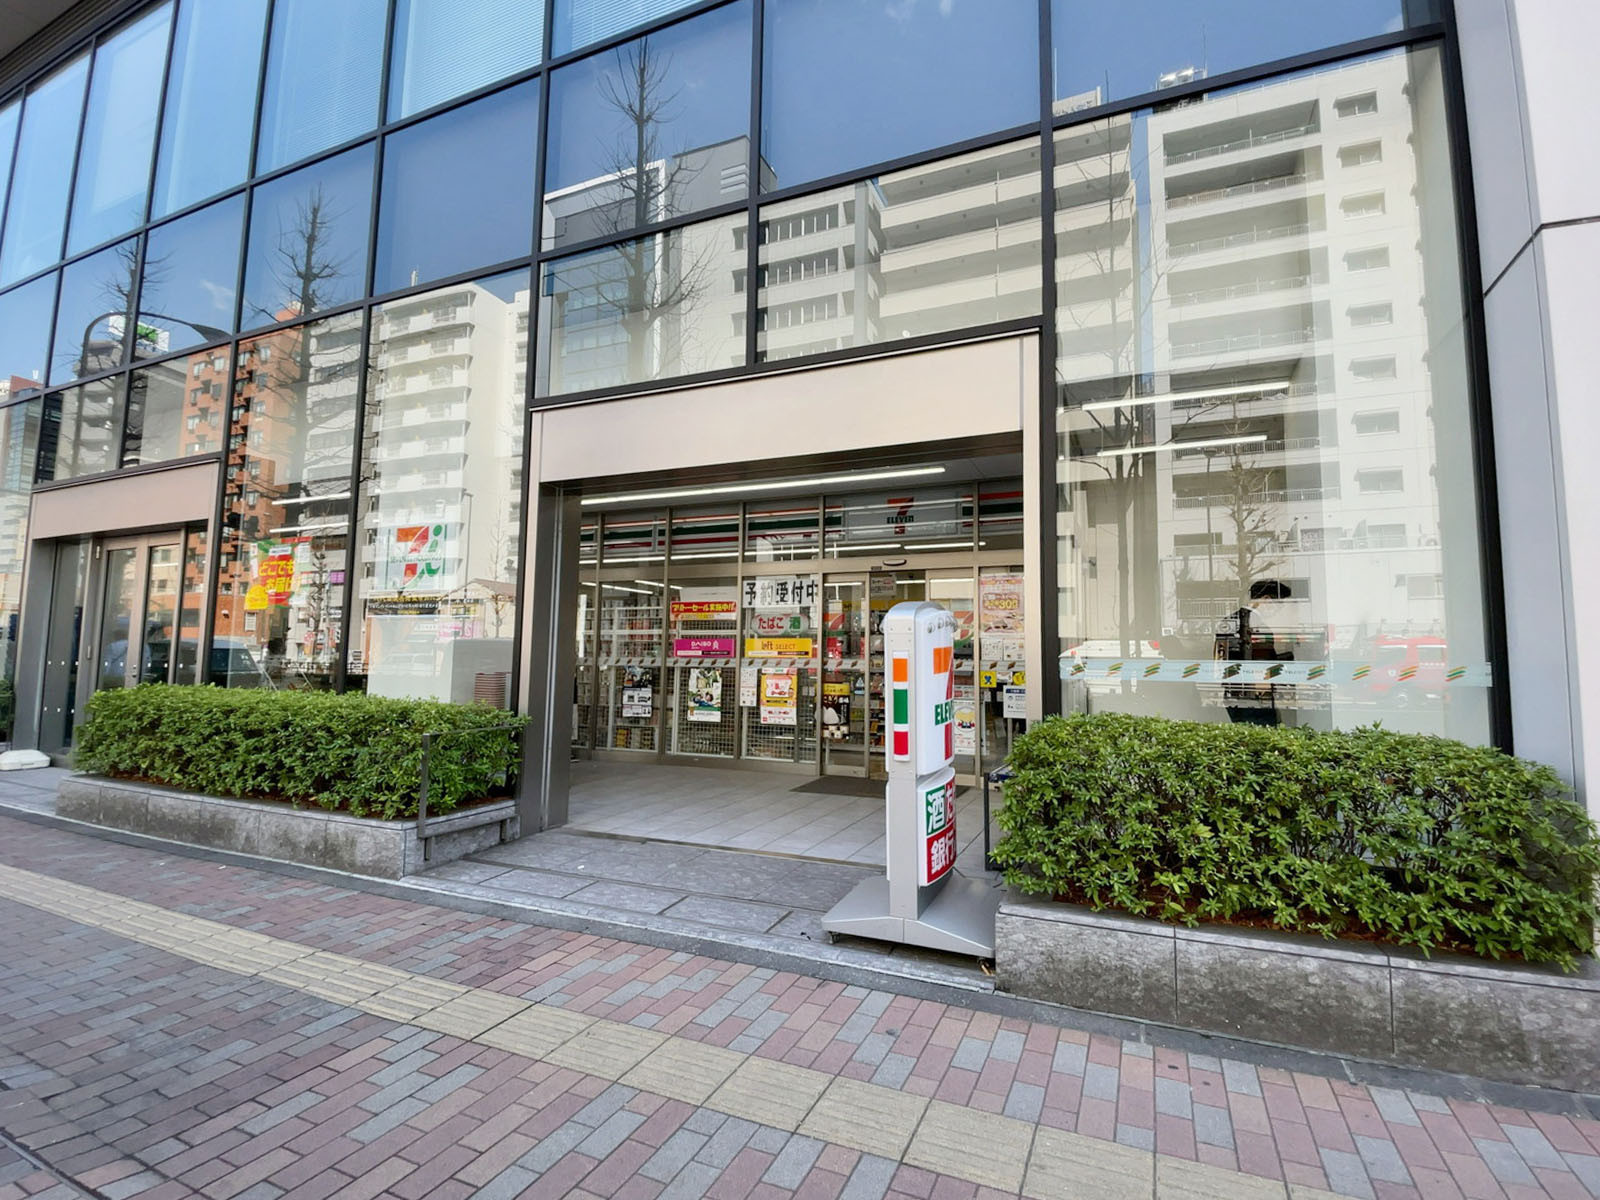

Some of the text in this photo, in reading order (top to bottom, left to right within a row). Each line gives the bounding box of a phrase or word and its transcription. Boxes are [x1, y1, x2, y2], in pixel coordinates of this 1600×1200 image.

[259, 560, 294, 577] どこでも
[745, 579, 819, 606] 予約受付中
[758, 616, 785, 630] たばこ
[927, 789, 945, 834] 酒
[931, 829, 955, 874] 銀行
